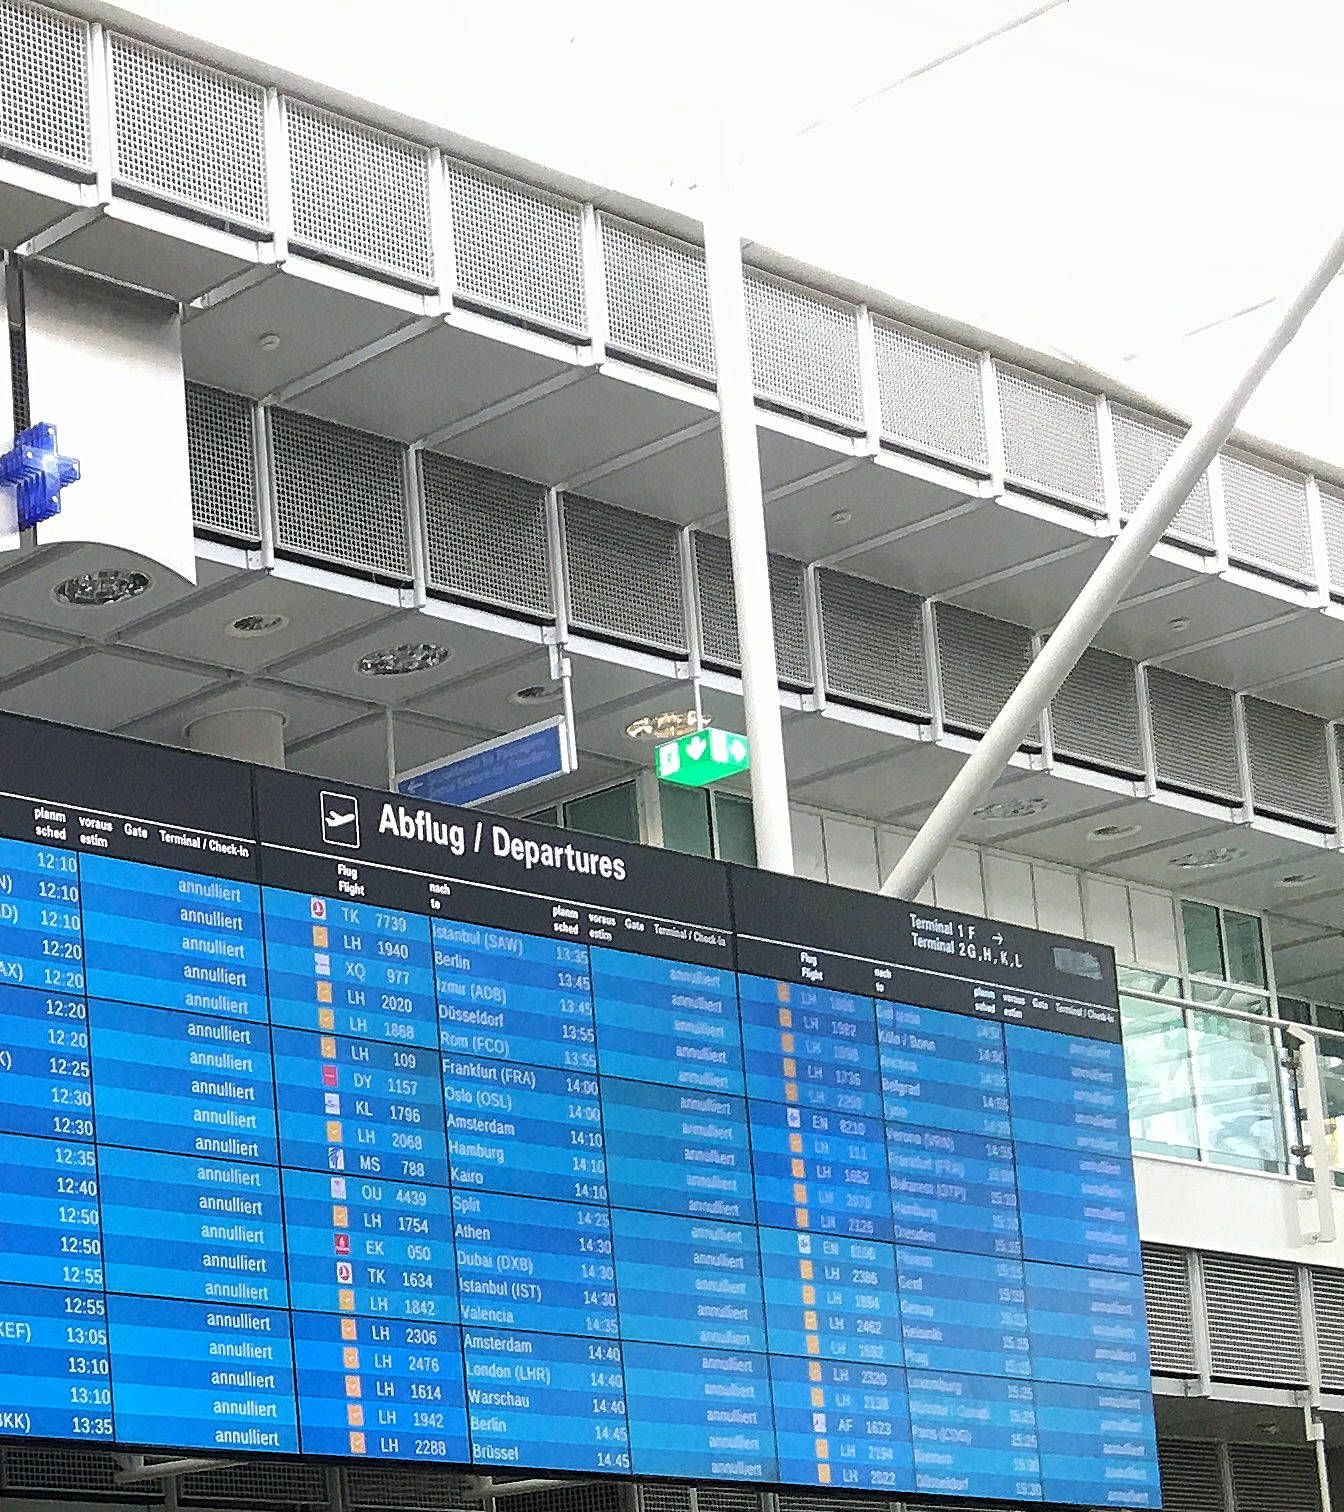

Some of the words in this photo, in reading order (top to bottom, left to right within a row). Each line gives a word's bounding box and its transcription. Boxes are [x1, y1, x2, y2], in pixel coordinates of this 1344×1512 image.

[34, 807, 66, 822] planm
[79, 817, 113, 831] voraus
[124, 823, 147, 838] Gate
[159, 830, 200, 848] Terminal
[209, 839, 249, 857] Check-In
[36, 825, 66, 840] sched
[80, 834, 108, 847] estim
[379, 804, 464, 855] Abflug
[474, 822, 482, 852] /
[493, 826, 625, 880] Departures
[39, 882, 79, 904] 12:10
[181, 909, 242, 930] annulliert
[910, 914, 953, 936] Terminal
[968, 926, 975, 939] F
[912, 932, 954, 954] Terminal
[57, 1178, 97, 1196] 12:40
[200, 1197, 262, 1215] annulliert
[464, 1334, 532, 1352] Amsterdam
[73, 1417, 113, 1436] 13:35
[216, 1429, 279, 1448] annulliert
